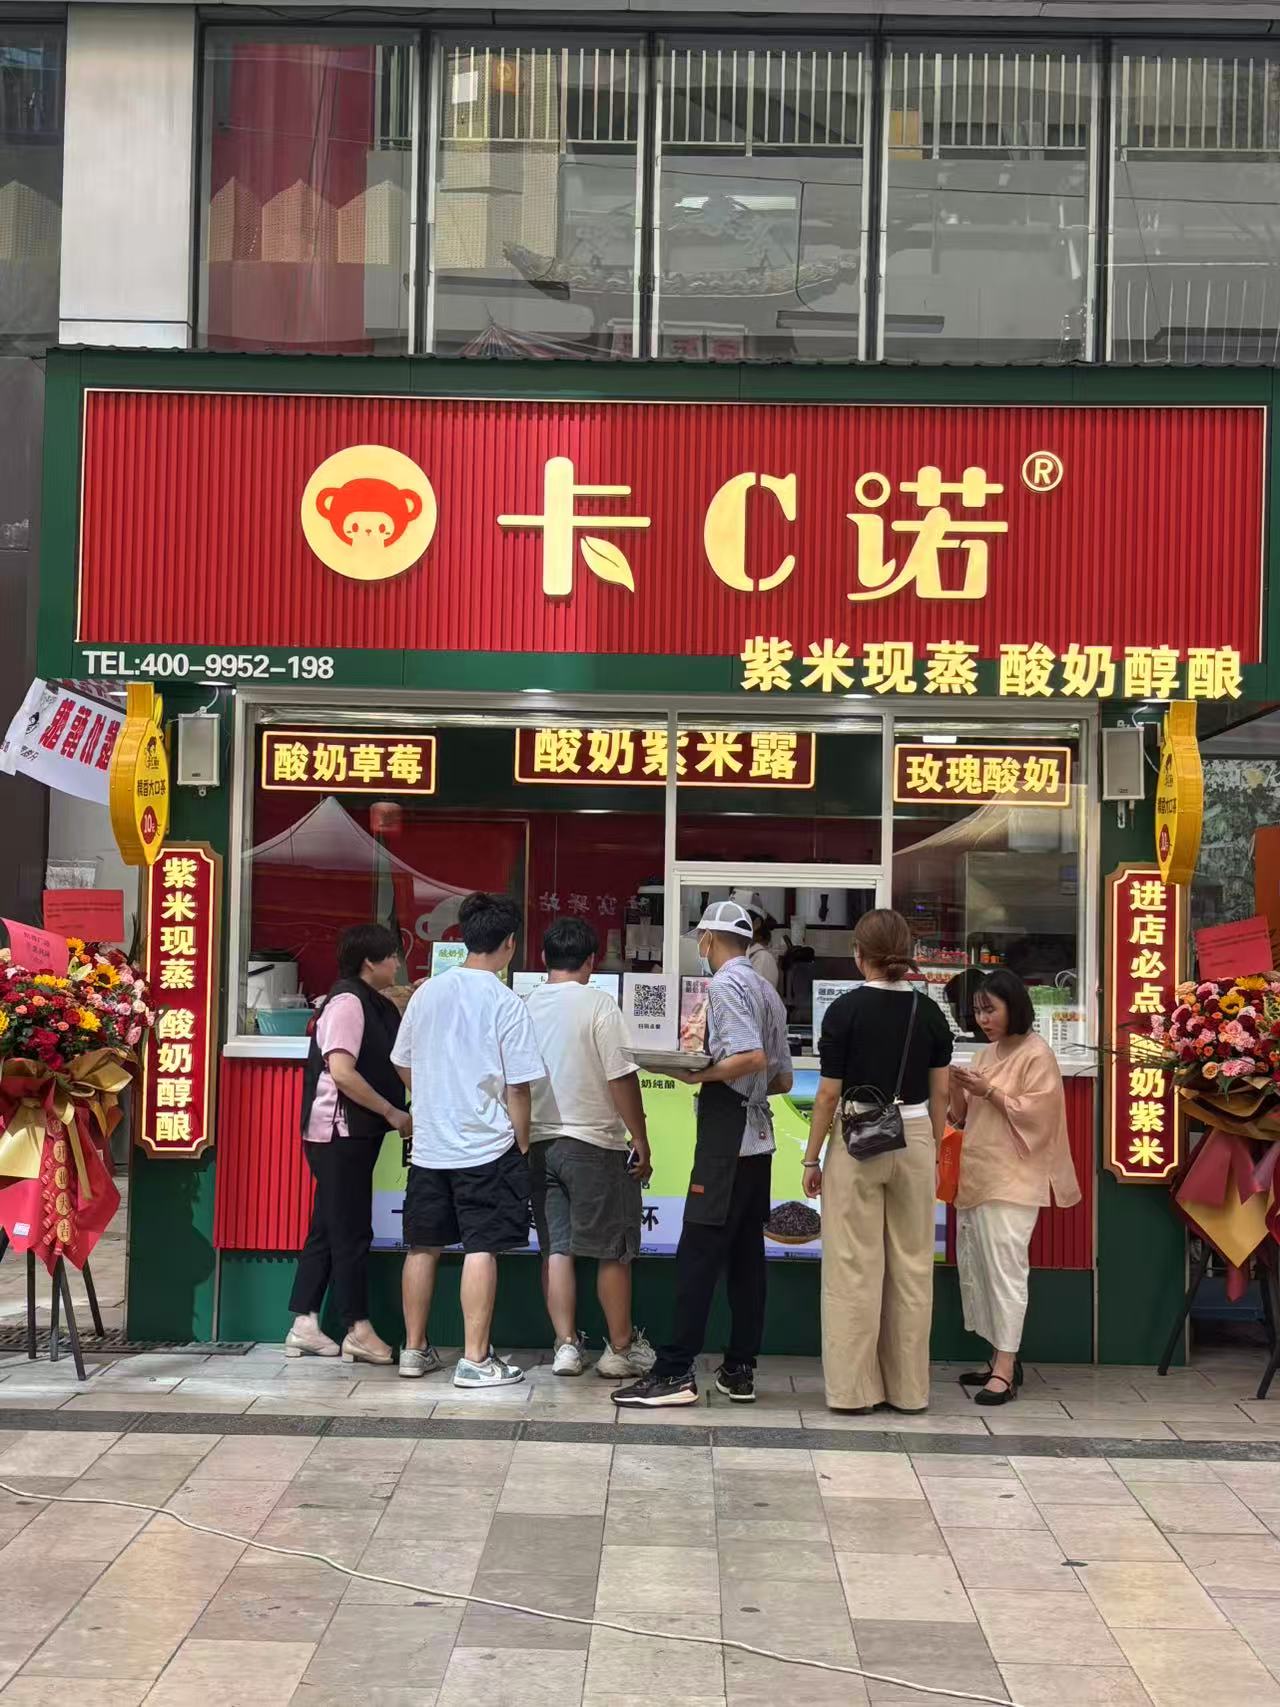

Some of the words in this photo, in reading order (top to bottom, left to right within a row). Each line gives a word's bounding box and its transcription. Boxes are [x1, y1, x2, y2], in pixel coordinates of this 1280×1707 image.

[82, 650, 335, 680] TEL:400-9952-198
[740, 636, 979, 695] 紫米现蒸
[999, 643, 1243, 700] 酸奶醇酿
[273, 742, 423, 784] 酸奶草莓
[533, 728, 797, 780] 酸奶紫米露
[905, 753, 1060, 796] 玫瑰酸奶
[159, 856, 199, 990] 紫米现蒸
[1129, 880, 1167, 1014] 进店必点
[156, 1008, 195, 1142] 酸奶醇酿
